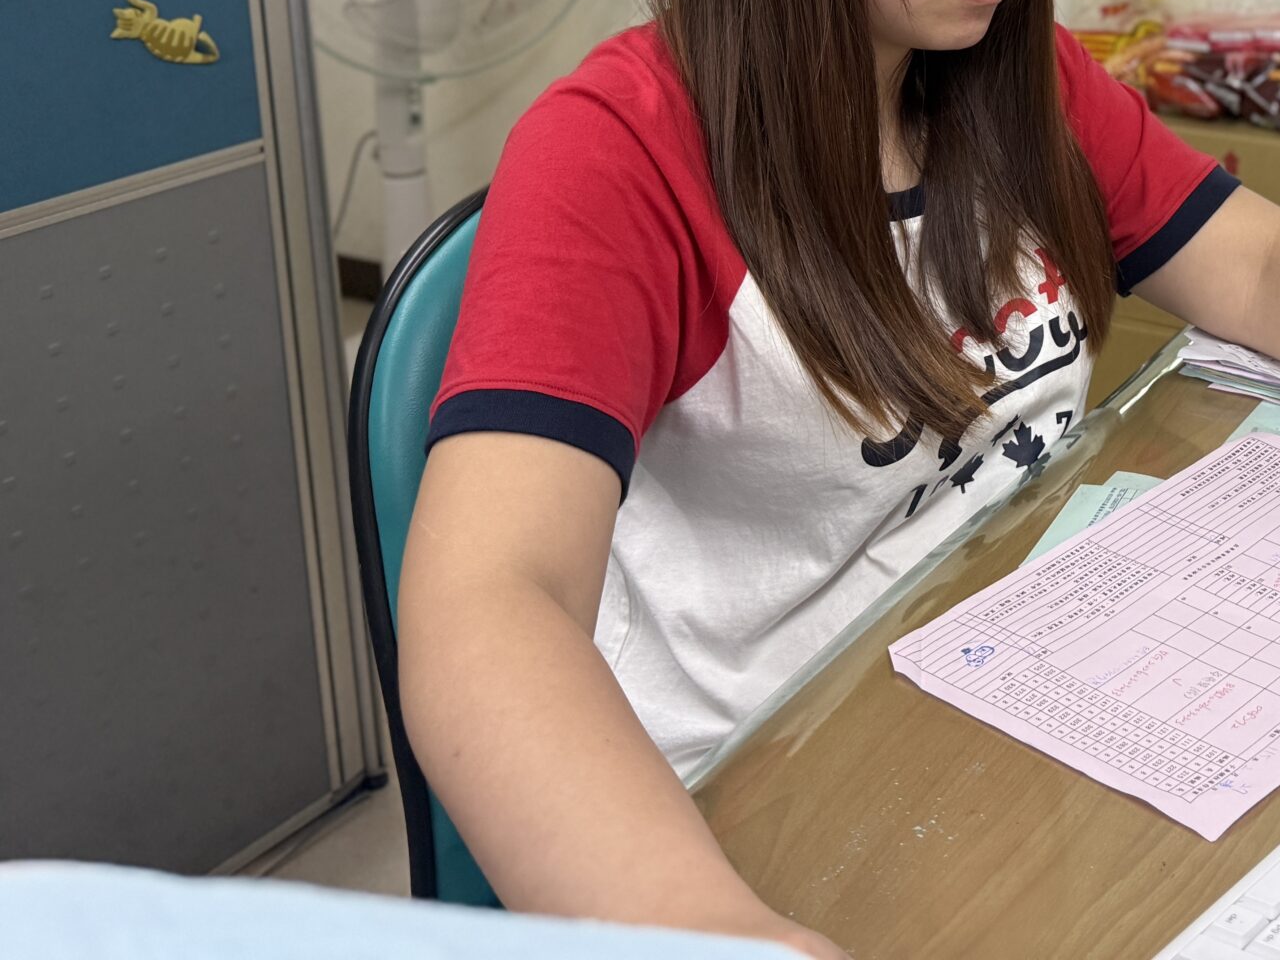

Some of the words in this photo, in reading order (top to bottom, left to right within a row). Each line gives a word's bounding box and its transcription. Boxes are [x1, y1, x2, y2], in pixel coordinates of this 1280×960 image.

[1157, 727, 1169, 735] 121
[1181, 738, 1192, 747] 111
[1205, 749, 1217, 758] 102
[1165, 764, 1177, 773] 227
